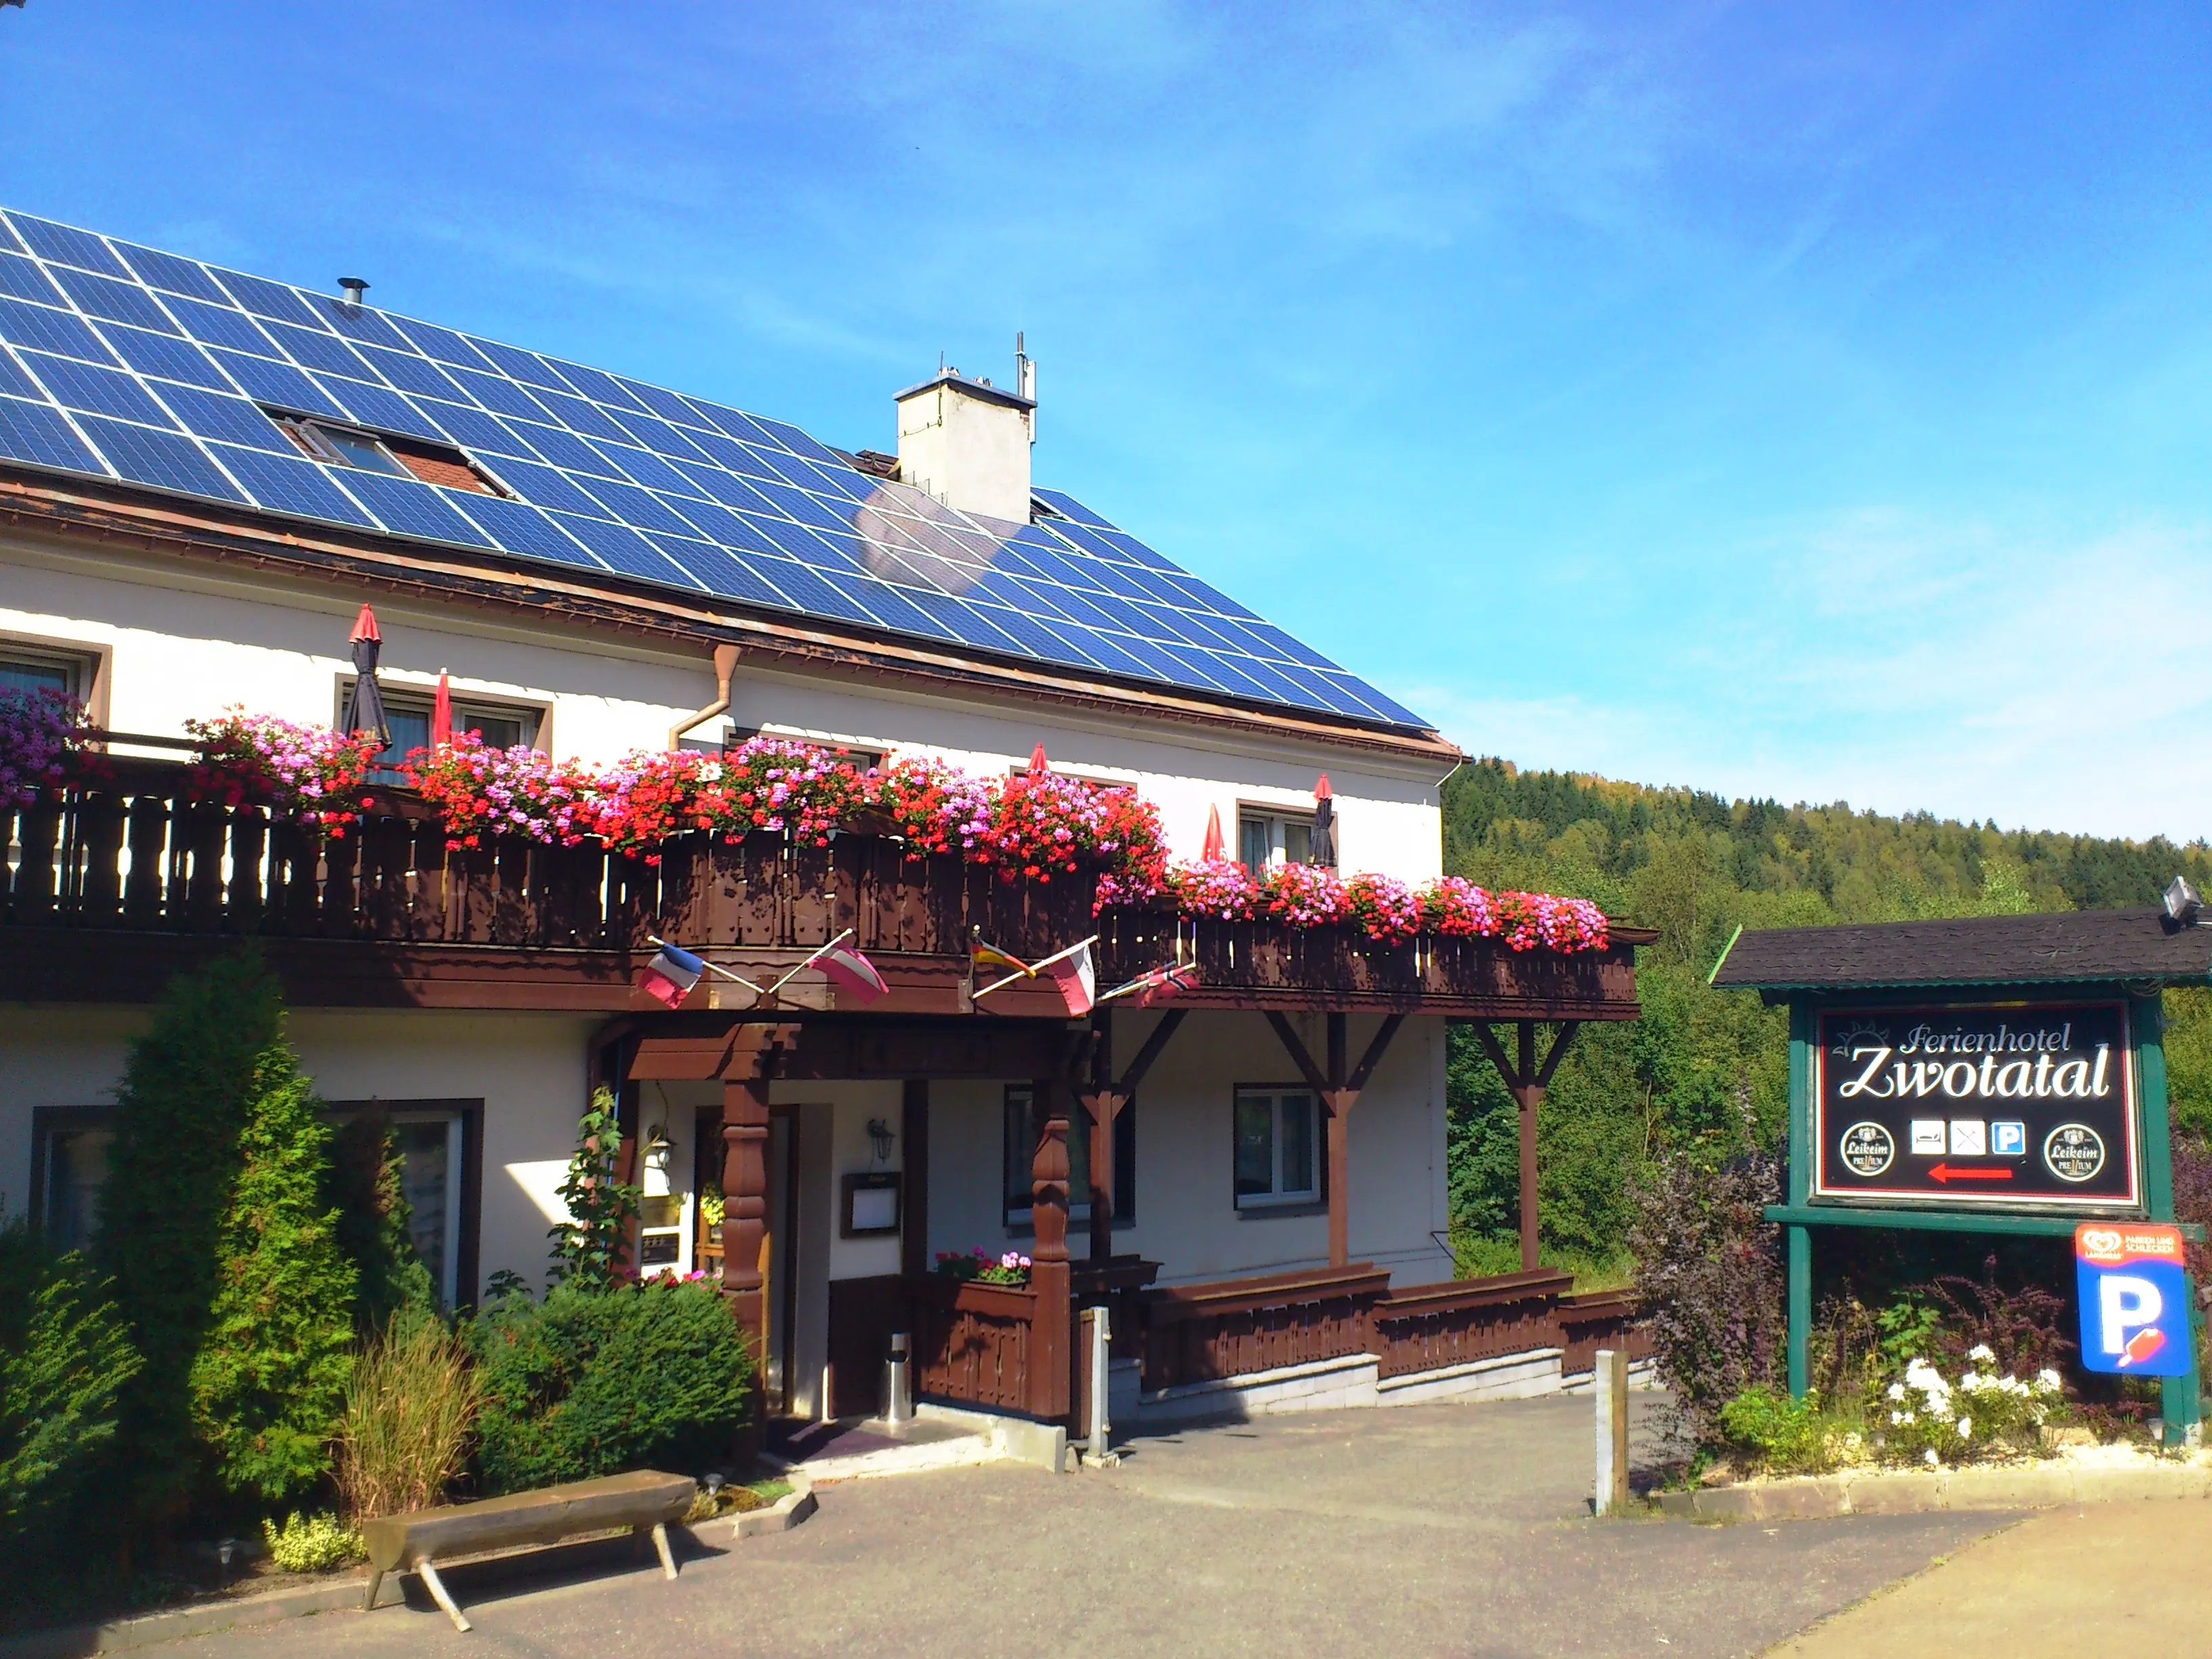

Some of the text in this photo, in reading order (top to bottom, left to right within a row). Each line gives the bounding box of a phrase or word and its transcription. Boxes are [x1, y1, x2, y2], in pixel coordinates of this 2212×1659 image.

[1900, 1023, 2072, 1054] Ferienhotel
[1840, 1043, 2110, 1098] Zwotatal
[1847, 1141, 1888, 1155] Leikeim
[1998, 1126, 2020, 1151] P
[2051, 1145, 2097, 1159] Leikeim
[2100, 1275, 2162, 1354] P
